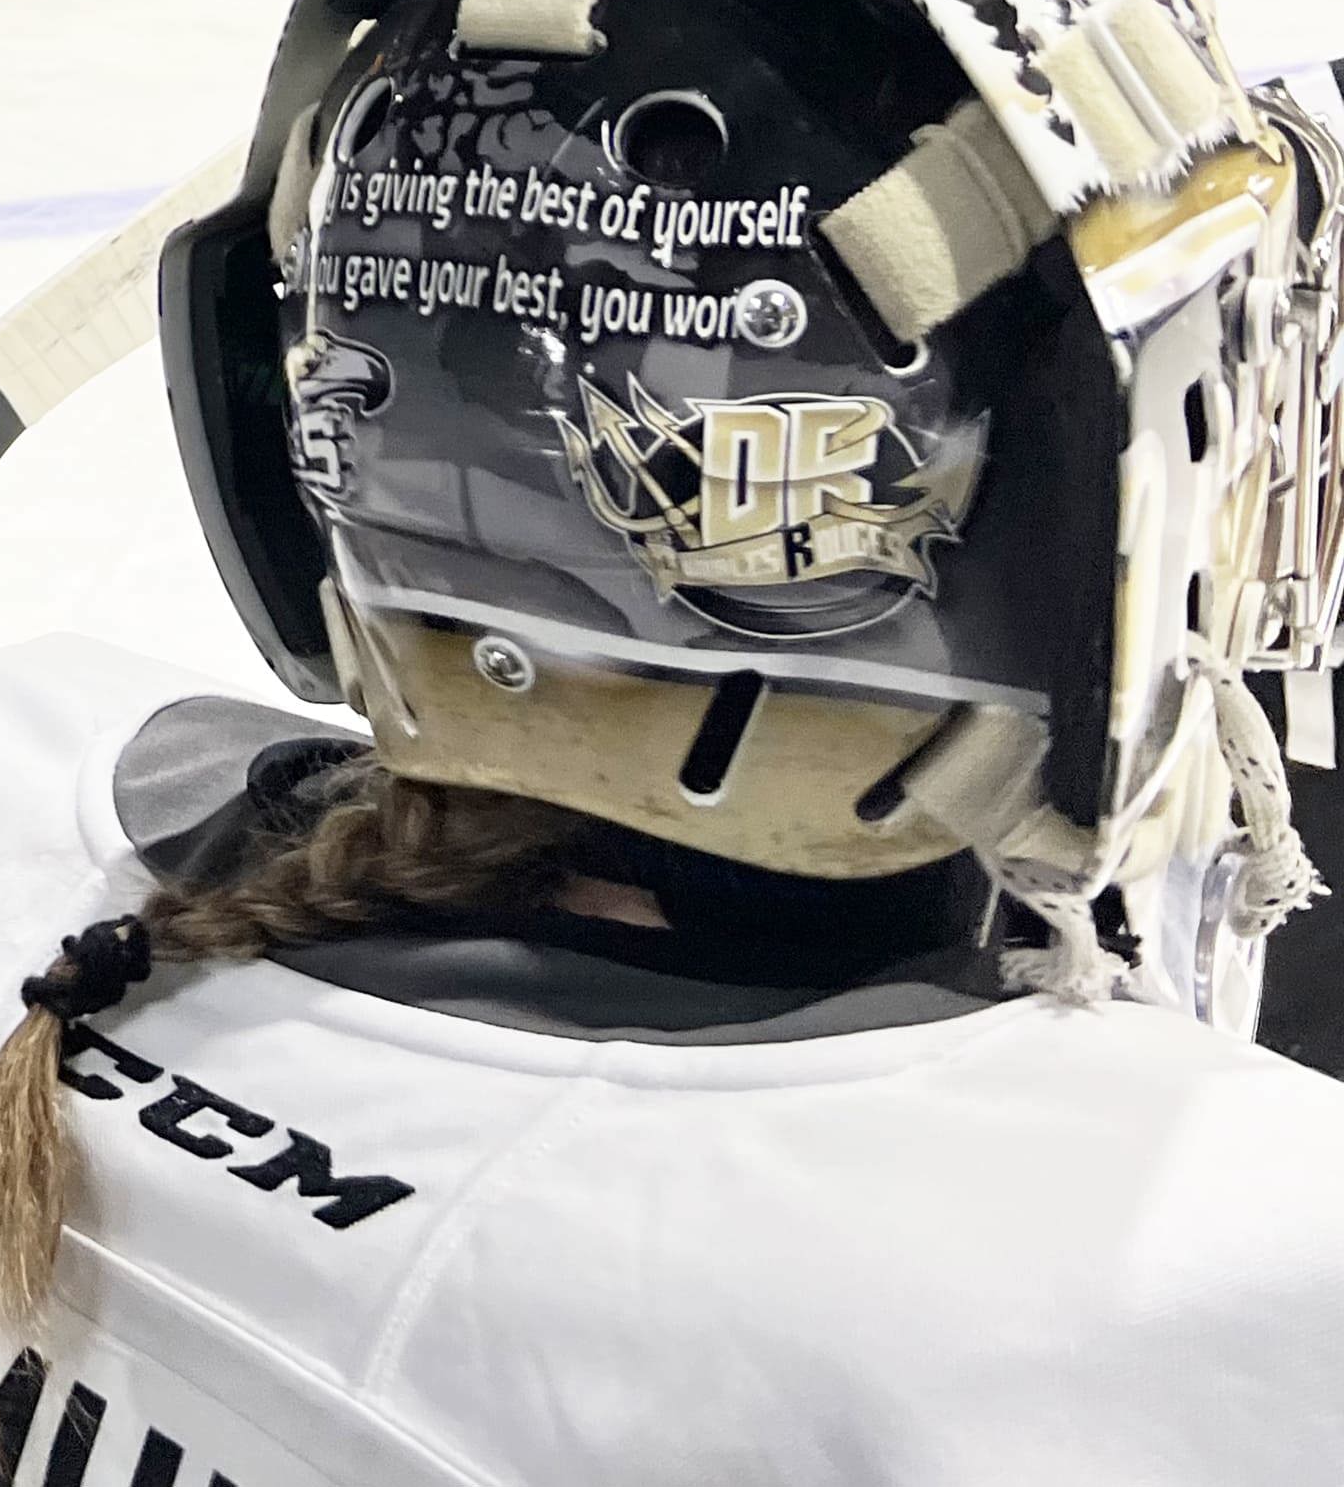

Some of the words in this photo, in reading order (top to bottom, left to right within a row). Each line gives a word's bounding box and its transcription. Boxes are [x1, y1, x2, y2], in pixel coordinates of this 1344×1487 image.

[340, 157, 361, 211] is
[363, 160, 458, 230] giving
[464, 163, 518, 219] the
[521, 167, 591, 229] best
[600, 183, 651, 239] of
[653, 187, 809, 268] yourself
[345, 260, 410, 310] gave
[420, 263, 489, 316] your
[494, 255, 568, 329] best,
[580, 284, 649, 343] you
[58, 1022, 416, 1230] CCM
